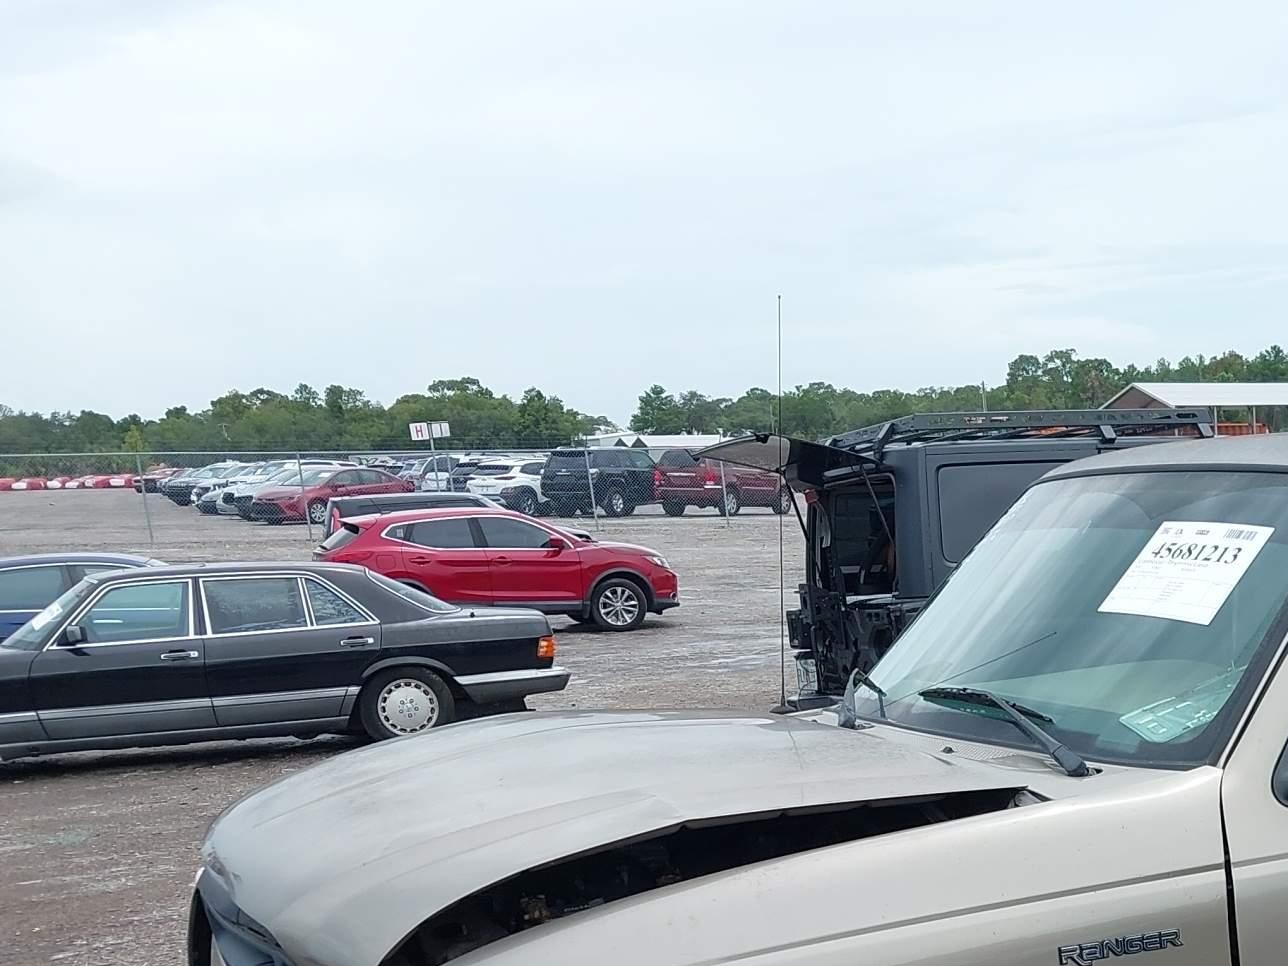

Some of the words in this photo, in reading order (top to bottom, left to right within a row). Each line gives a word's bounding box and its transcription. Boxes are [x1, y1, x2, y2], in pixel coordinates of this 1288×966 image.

[415, 425, 423, 438] H
[1151, 541, 1243, 565] 45681213
[1058, 928, 1184, 966] RANGER
